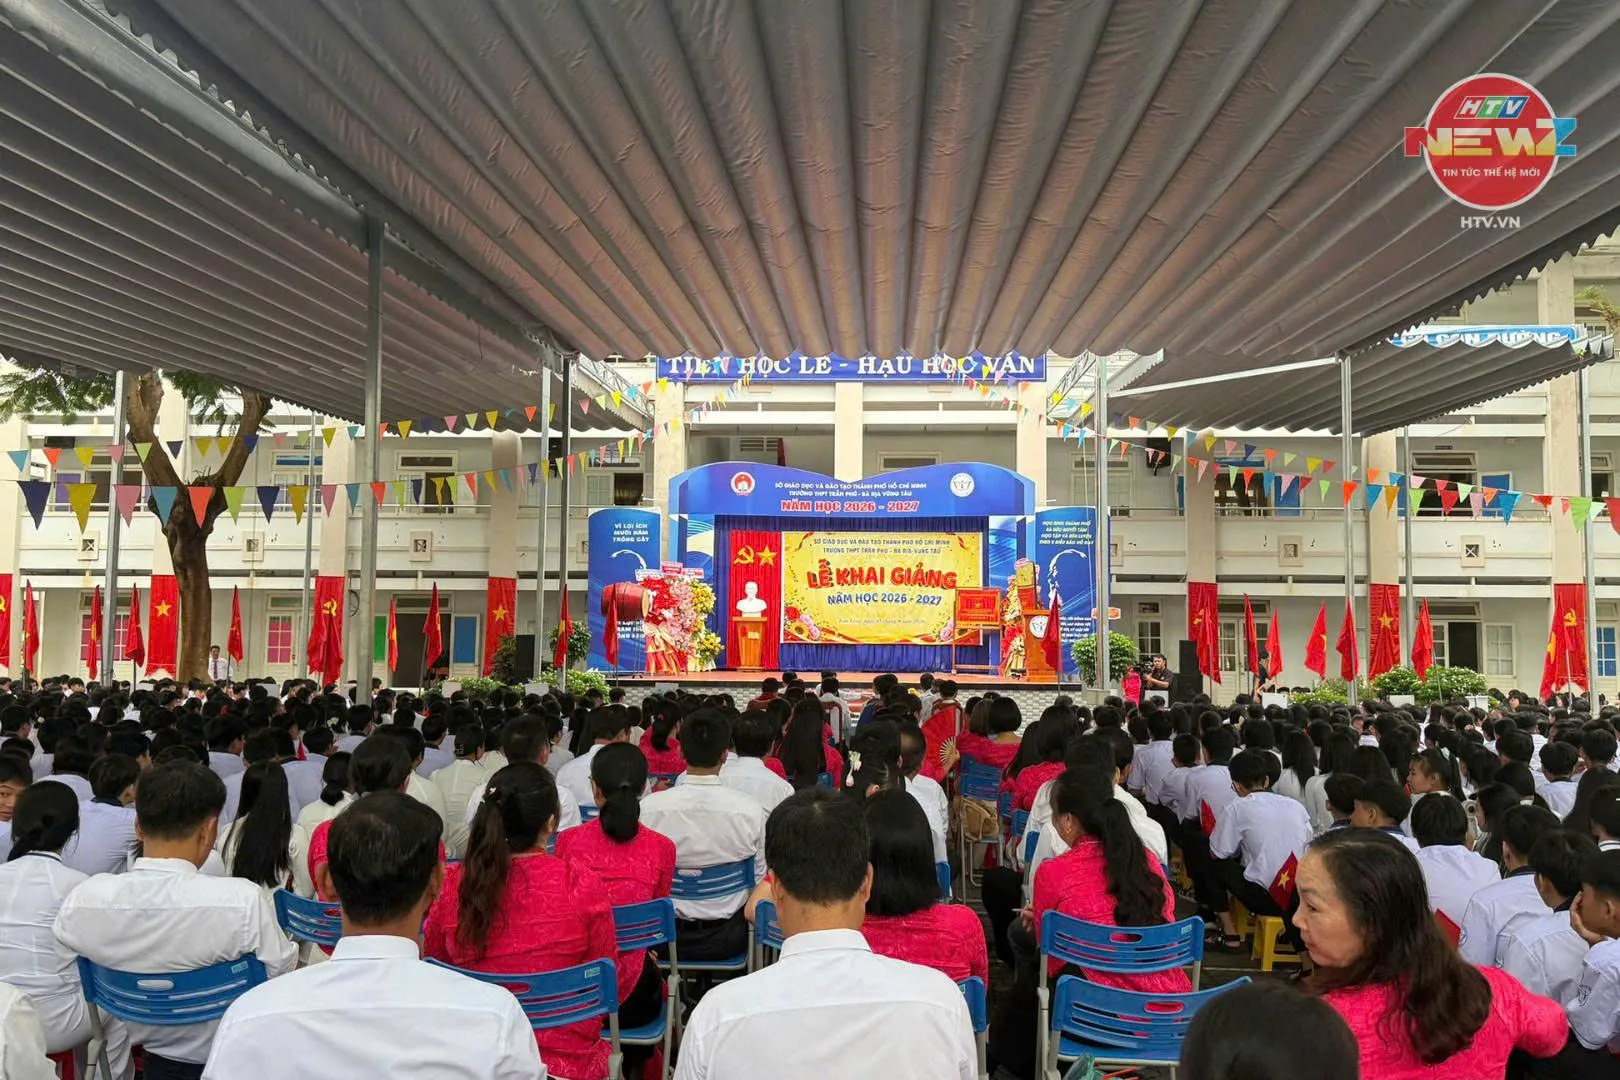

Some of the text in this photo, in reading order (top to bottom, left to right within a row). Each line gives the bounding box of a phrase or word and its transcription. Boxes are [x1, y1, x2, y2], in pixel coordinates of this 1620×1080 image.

[737, 355, 791, 378] HỌC
[781, 498, 811, 512] NĂM
[814, 501, 841, 514] HỌC
[844, 500, 876, 512] 2026
[887, 500, 920, 512] 2027
[807, 558, 958, 590] LỄ KHAI GIẢNG
[828, 592, 852, 605] NĂM
[855, 593, 879, 606] HỌC
[882, 593, 908, 603] 2026
[916, 594, 942, 606] 2027
